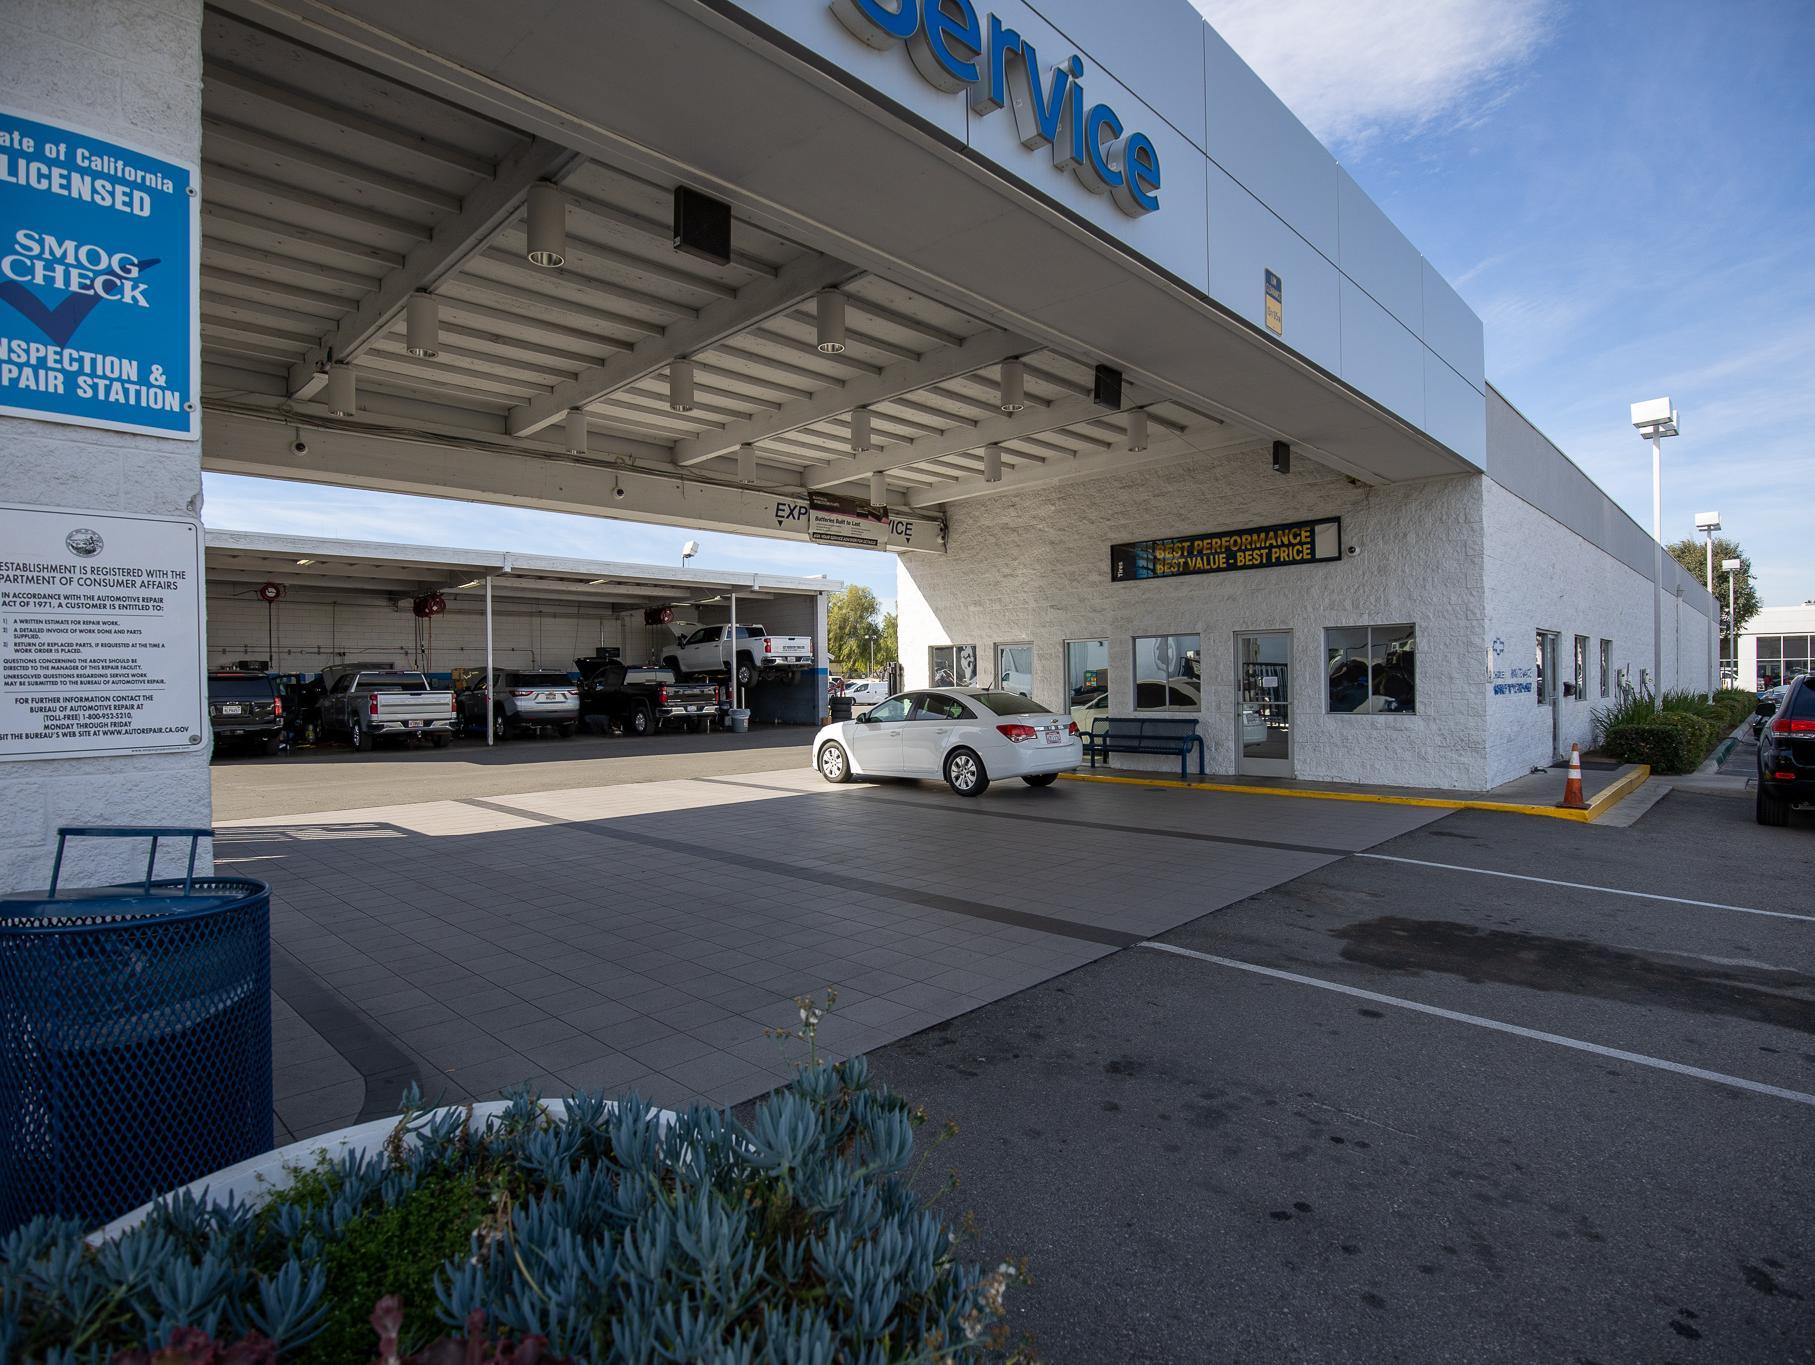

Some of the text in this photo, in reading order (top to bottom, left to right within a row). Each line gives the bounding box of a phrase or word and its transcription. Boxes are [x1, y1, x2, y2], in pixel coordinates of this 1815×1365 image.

[45, 143, 66, 161] of
[76, 148, 173, 194] California
[0, 153, 151, 217] LICENSED
[14, 230, 139, 278] SMOG
[1, 255, 149, 308] CHECK
[149, 364, 167, 387] &
[2, 363, 180, 412] PAIR STATION
[776, 502, 808, 521] EXP
[889, 520, 913, 537] ICE
[1156, 527, 1311, 559] BEST PERFORMANCE
[1156, 559, 1185, 573] BEST
[1188, 554, 1227, 570] VALUE
[1237, 550, 1268, 566] BEST
[1272, 544, 1311, 562] PRICE
[0, 562, 186, 580] ESTABLISHMENT IS REGISTERED WITH THE
[60, 576, 74, 586] OF
[77, 577, 137, 589] CONSUMER
[140, 580, 178, 590] AFFAIRS
[12, 592, 61, 600] ACCORDANCE
[66, 602, 107, 610] CUSTOMER
[70, 704, 112, 712] AUTOMOTIVE
